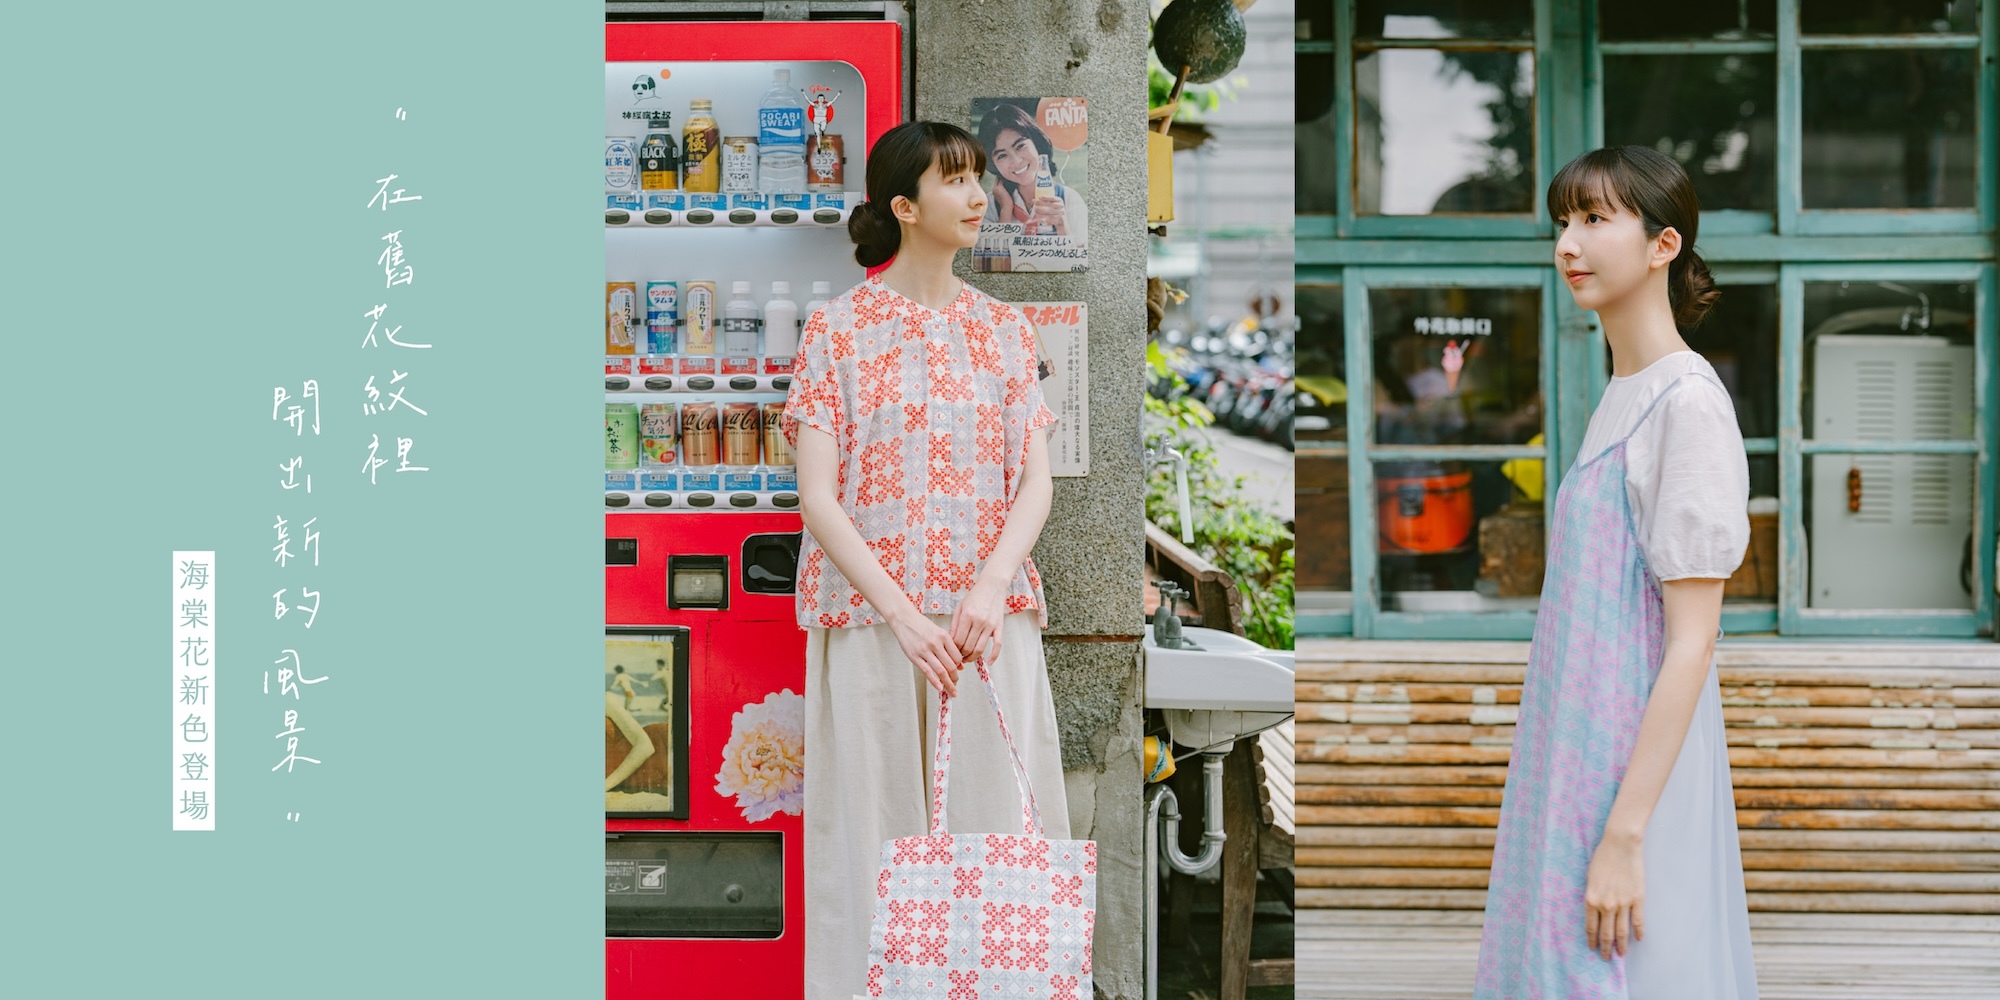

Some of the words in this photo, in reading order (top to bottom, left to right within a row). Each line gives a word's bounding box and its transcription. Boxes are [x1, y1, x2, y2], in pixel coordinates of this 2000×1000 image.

[760, 112, 800, 120] POCARI
[1045, 106, 1088, 126] FANTA
[686, 133, 708, 153] 極
[642, 147, 666, 158] BLACK
[980, 224, 1021, 233] レンジ色の
[1012, 237, 1071, 246] 風船はおいしい
[726, 320, 755, 331] コーヒー
[642, 415, 673, 427] チューハイ
[647, 426, 665, 435] 気分
